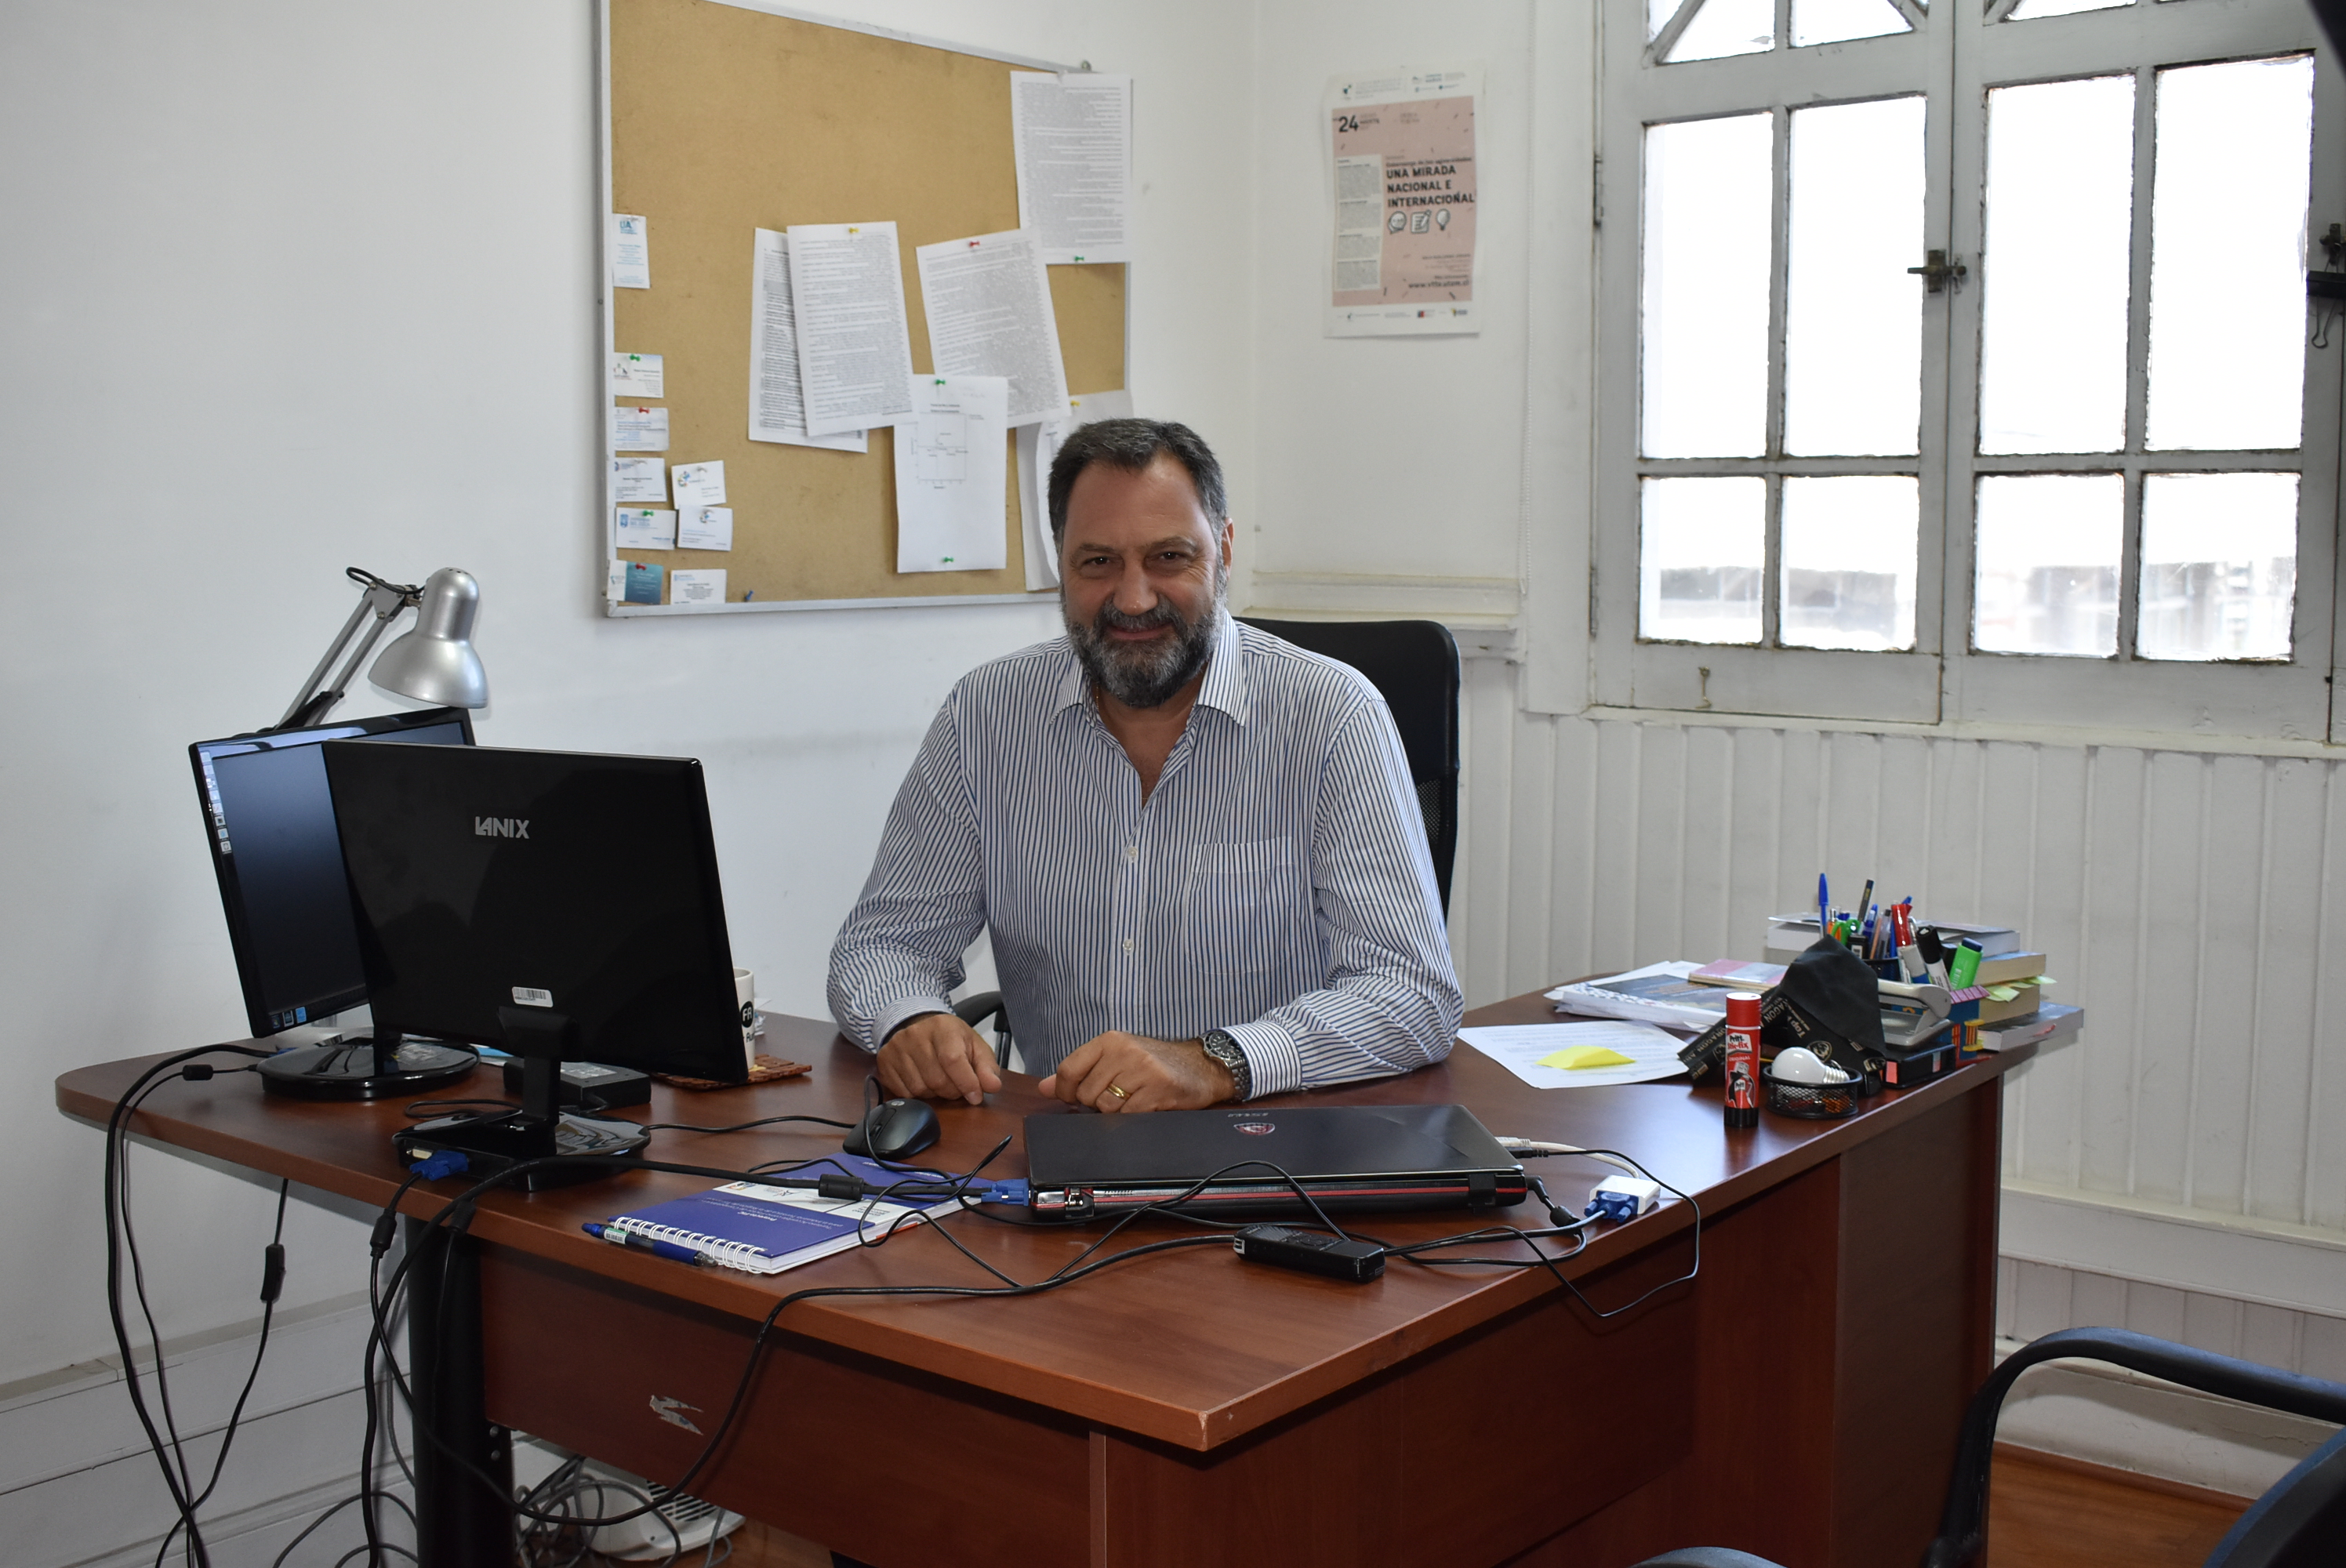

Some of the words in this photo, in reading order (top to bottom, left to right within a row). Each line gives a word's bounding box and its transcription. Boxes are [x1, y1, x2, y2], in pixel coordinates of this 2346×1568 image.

[1338, 114, 1359, 132] 24
[1386, 169, 1409, 180] UNA
[1412, 165, 1456, 177] MIRADA
[1387, 180, 1442, 194] NACIONAL
[1445, 179, 1452, 190] E
[1388, 192, 1475, 208] INTERNACIONAL
[475, 816, 530, 839] LANIX
[743, 1007, 753, 1022] FA
